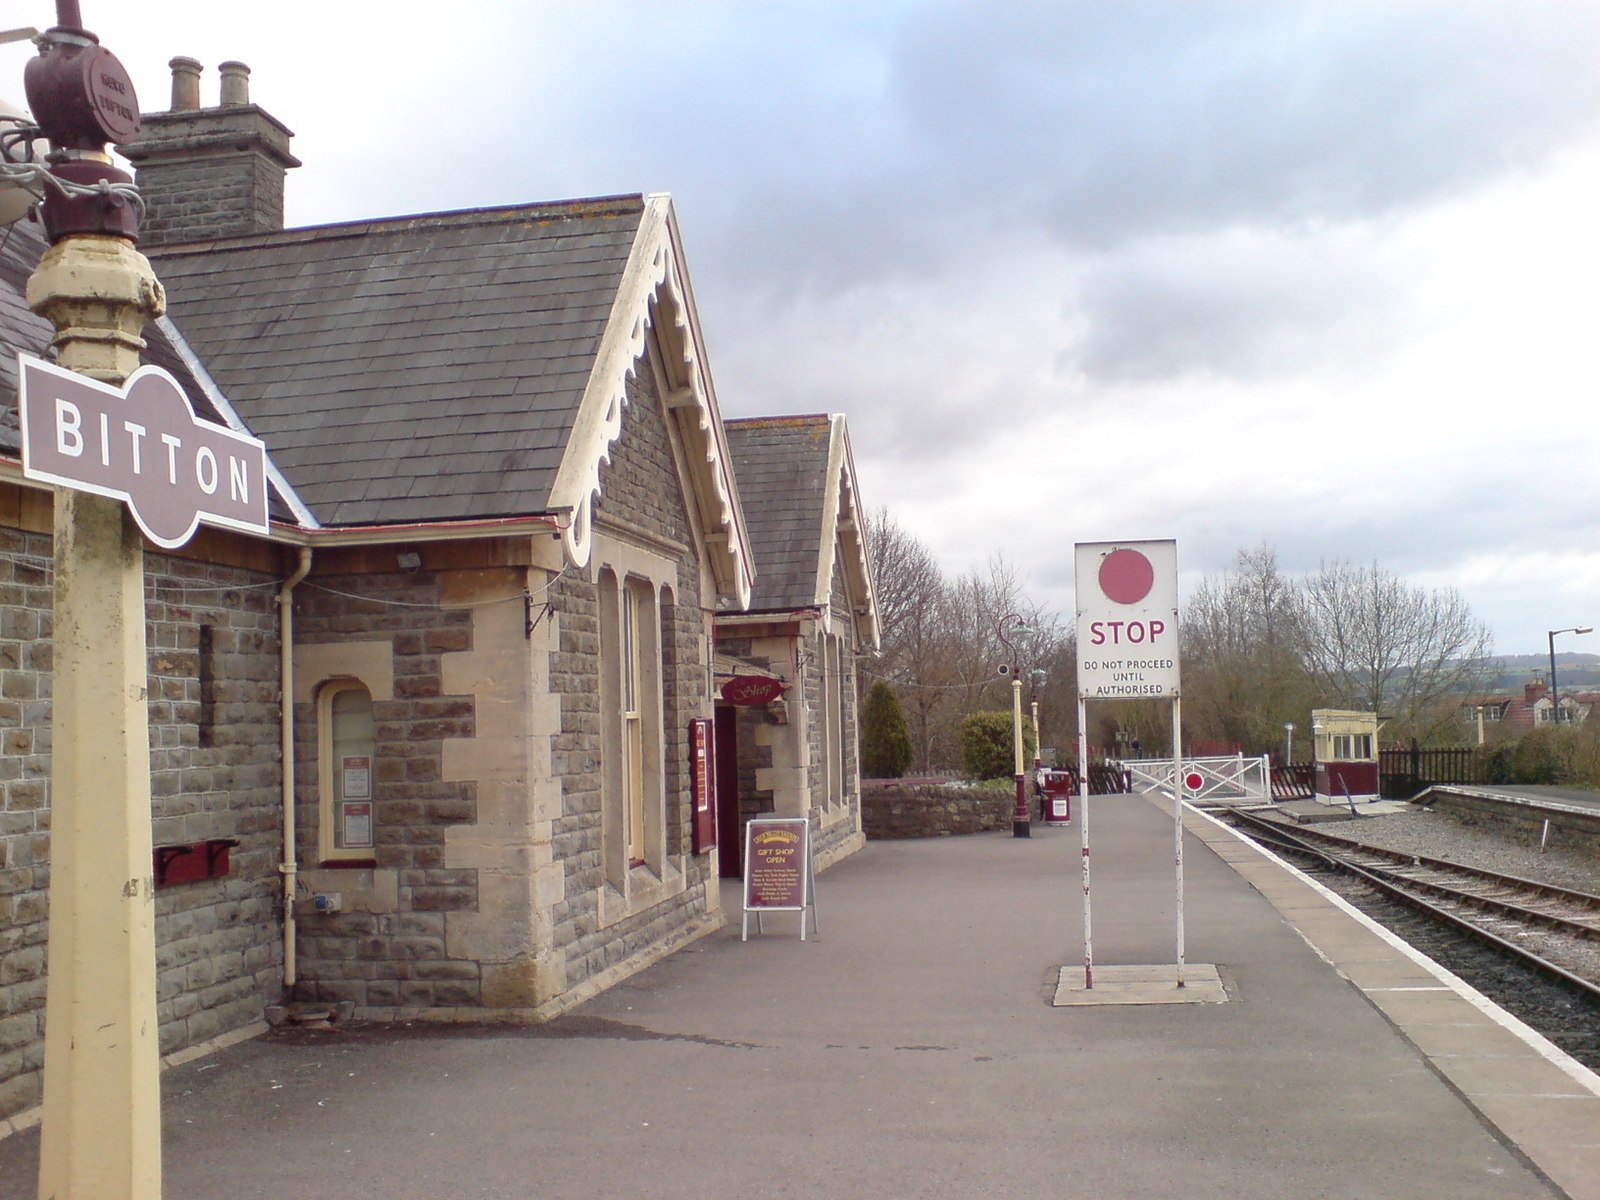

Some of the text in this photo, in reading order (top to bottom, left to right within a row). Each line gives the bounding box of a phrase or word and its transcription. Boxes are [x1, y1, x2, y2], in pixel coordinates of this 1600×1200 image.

[55, 398, 248, 504] BITTON
[1090, 621, 1165, 645] STOP
[1084, 660, 1173, 670] DO NOT PROCEED
[1113, 672, 1144, 681] UNTIL
[1096, 684, 1163, 695] AUTHORISED
[758, 848, 794, 856] GIFT SHOP
